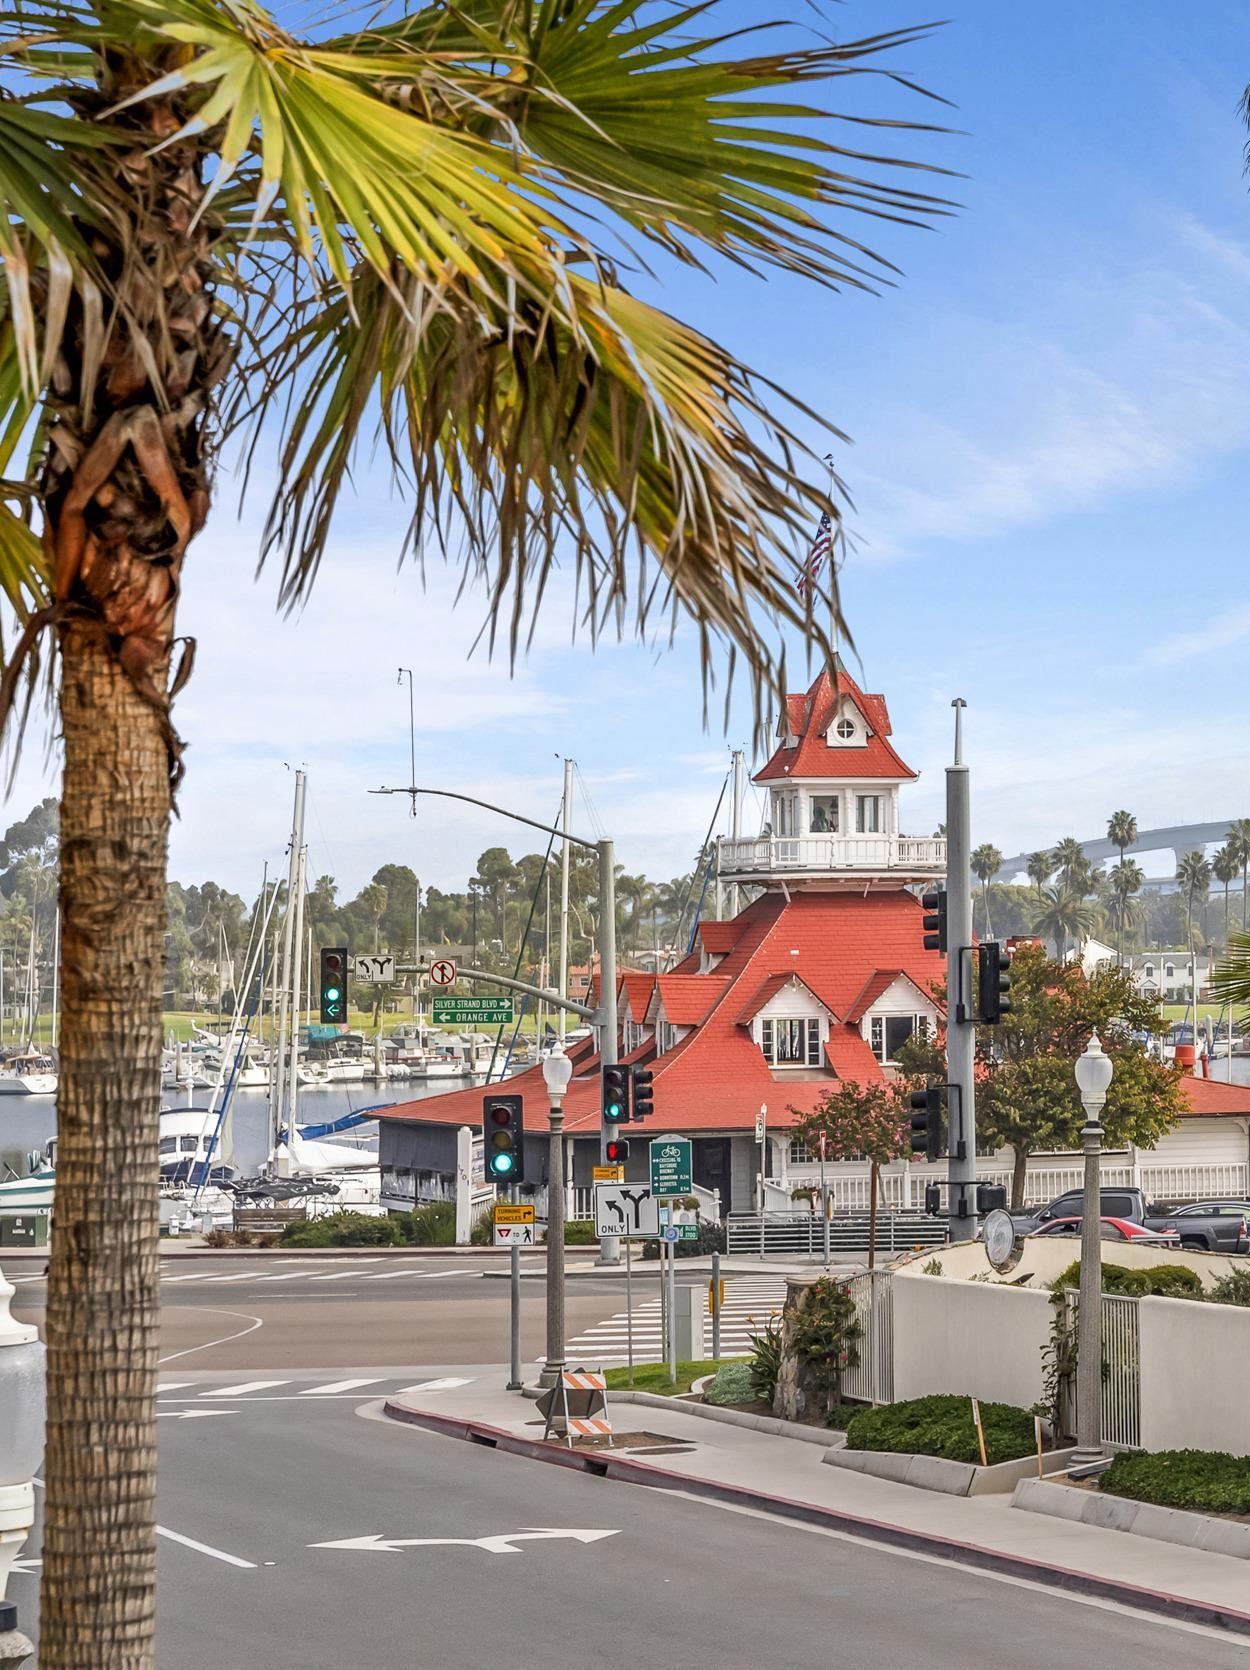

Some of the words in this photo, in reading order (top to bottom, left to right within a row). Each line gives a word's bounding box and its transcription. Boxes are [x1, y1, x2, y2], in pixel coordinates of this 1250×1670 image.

[434, 998, 455, 1008] SILVER
[456, 998, 480, 1008] STRAND
[482, 998, 497, 1008] BLVD
[456, 1012, 488, 1022] ORANGE
[492, 1012, 507, 1021] AVE
[601, 1225, 625, 1233] ONLY
